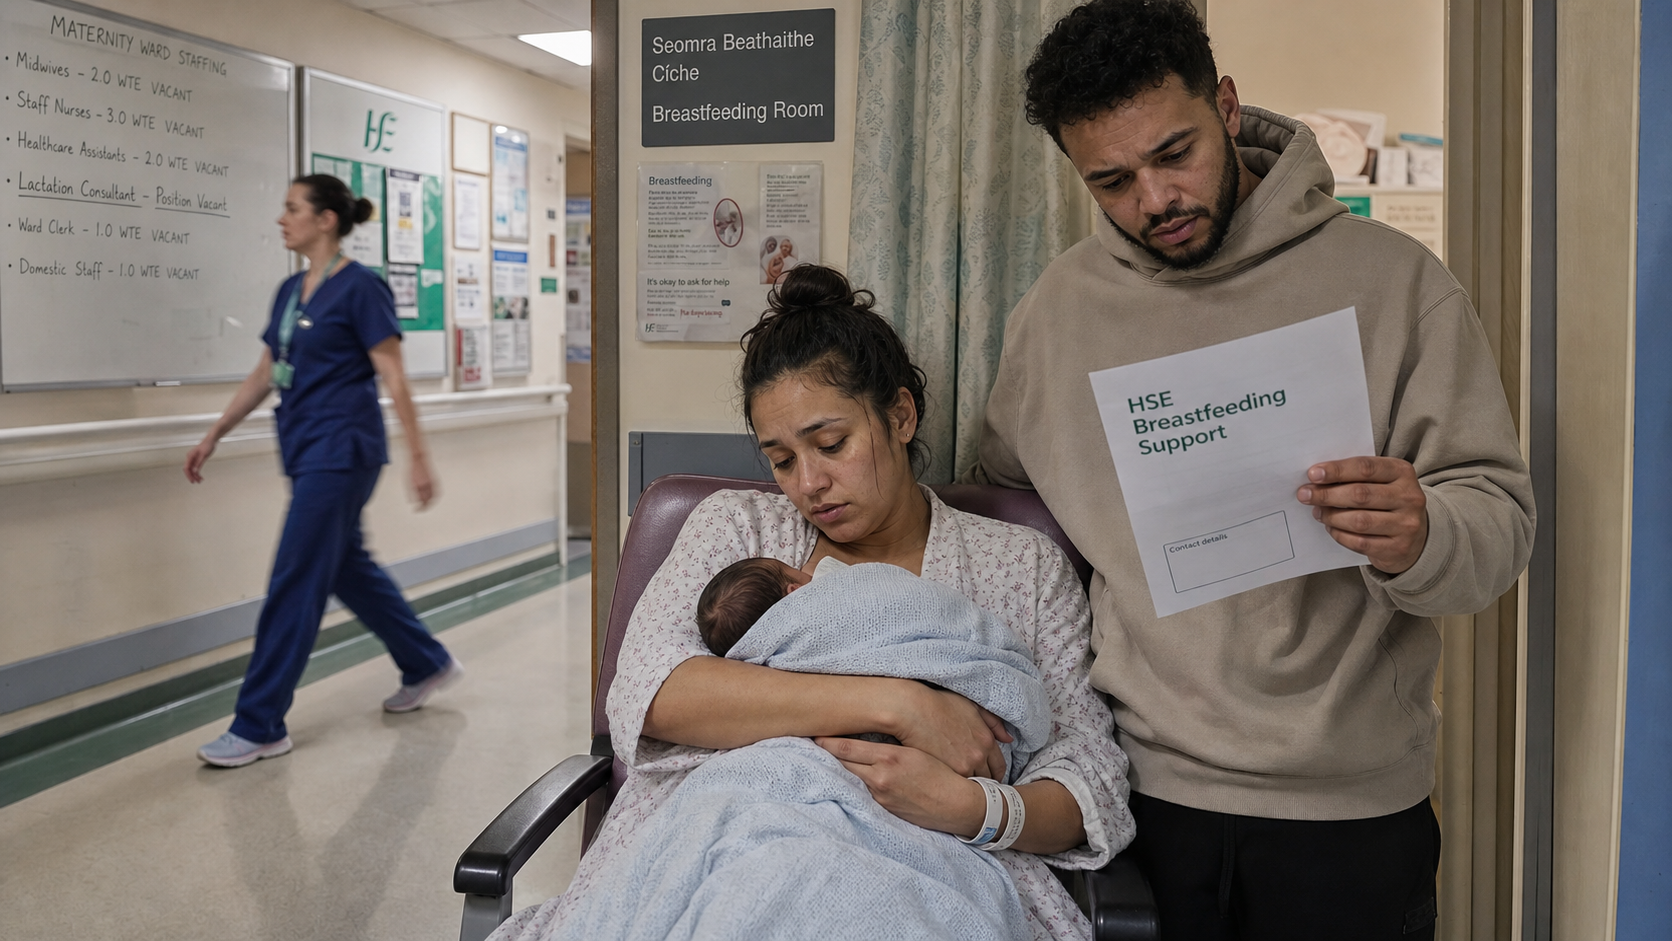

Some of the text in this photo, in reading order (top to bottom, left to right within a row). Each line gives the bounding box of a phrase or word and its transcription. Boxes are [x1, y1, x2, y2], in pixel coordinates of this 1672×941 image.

[50, 15, 227, 77] MATERNITY WARD STAFFING
[653, 31, 814, 54] Seomra Beathaithe
[16, 52, 70, 77] Midwives
[91, 67, 111, 85] 2.0
[118, 74, 141, 91] WTE
[151, 82, 192, 103] VACANT
[653, 64, 699, 82] Cíche
[17, 90, 50, 115] Staff
[55, 98, 91, 119] Nurses
[107, 108, 126, 124] 3.0
[132, 114, 155, 129] WTE
[165, 120, 204, 139] VACANT
[653, 101, 824, 123] Breastfeeding Room
[18, 132, 74, 154] Healthcare
[80, 142, 126, 162] Assistants
[145, 151, 162, 167] 2.0
[168, 157, 188, 171] WTE
[195, 162, 229, 177] VACANT
[19, 172, 73, 195] Lactation
[81, 180, 136, 202] Consultant
[156, 187, 191, 207] Position
[197, 194, 227, 211] Vacant
[649, 176, 712, 187] Breastfeeding
[19, 218, 42, 233] Ward
[49, 220, 75, 235] Clerk
[96, 222, 112, 237] 1.0
[120, 226, 141, 240] WTE
[152, 229, 189, 244] VACANT
[20, 258, 67, 276] Domestic
[75, 261, 103, 281] Staff
[120, 263, 135, 277] 1.0
[140, 265, 160, 277] WTE
[167, 267, 199, 281] VACANT
[659, 278, 676, 286] okay
[714, 278, 730, 287] help
[1127, 391, 1174, 414] HSE
[1133, 389, 1286, 434] Breastfeeding
[1139, 425, 1228, 456] Support
[1169, 540, 1200, 553] Contact
